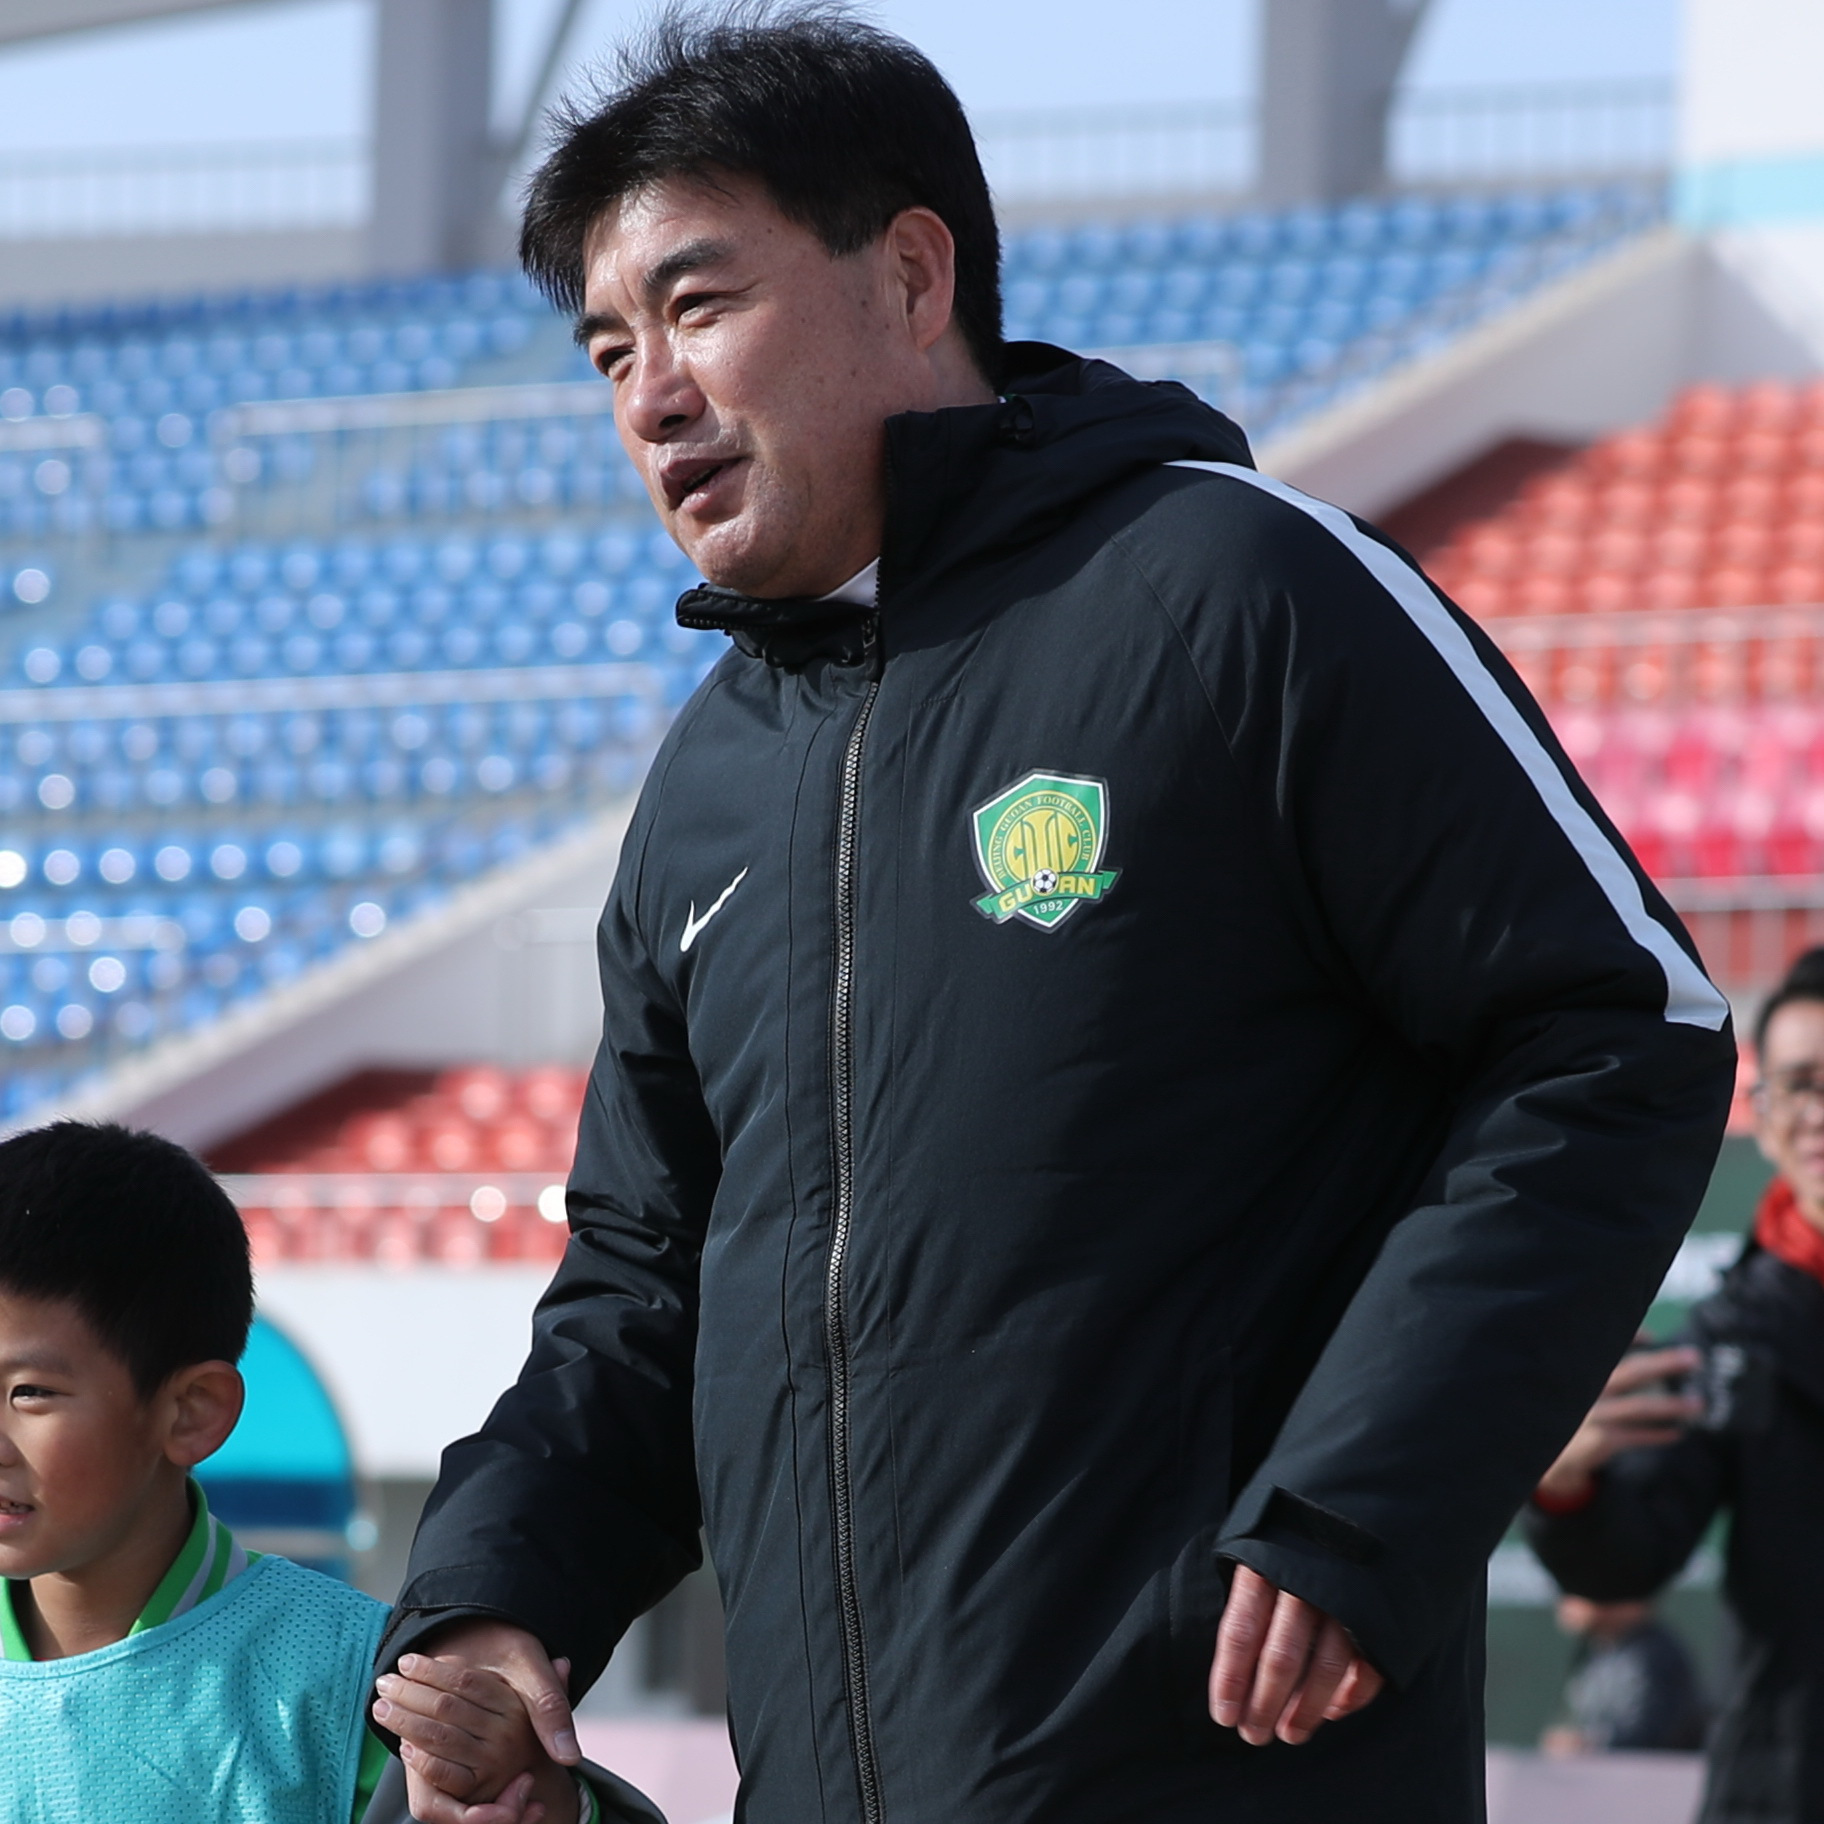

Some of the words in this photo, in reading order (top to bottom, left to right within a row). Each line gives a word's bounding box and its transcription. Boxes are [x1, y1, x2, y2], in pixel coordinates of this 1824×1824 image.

[992, 836, 1006, 880] BEIJING
[1001, 800, 1033, 832] GUOAN
[1036, 795, 1085, 827] FOOTBALL
[1081, 829, 1092, 861] CLUB
[1033, 900, 1064, 915] 1992
